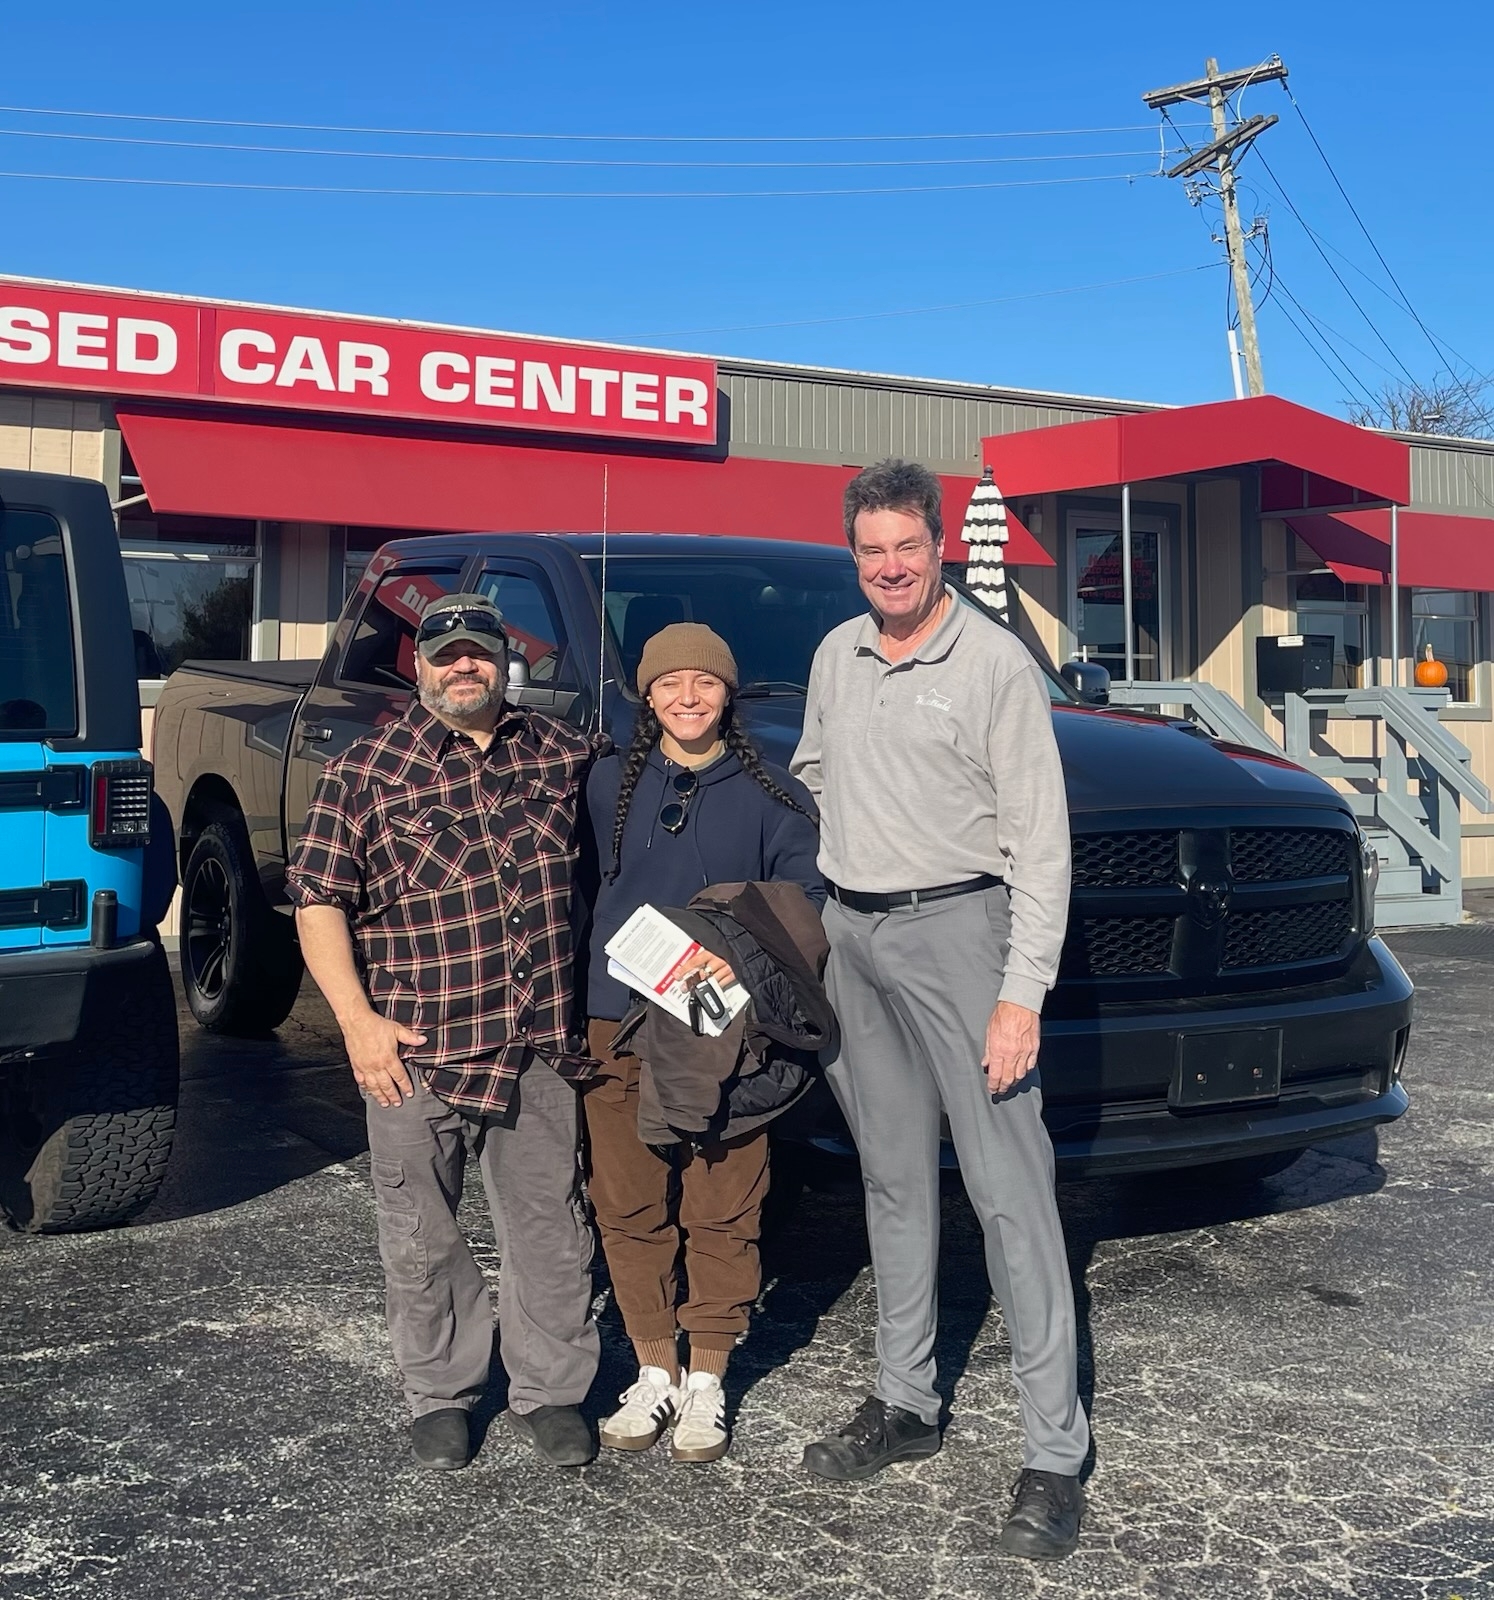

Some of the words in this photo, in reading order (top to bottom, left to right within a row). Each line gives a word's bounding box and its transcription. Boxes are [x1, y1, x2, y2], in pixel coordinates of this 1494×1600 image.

[0, 306, 178, 375] SED
[219, 328, 390, 397] CAR
[420, 351, 709, 426] CENTER
